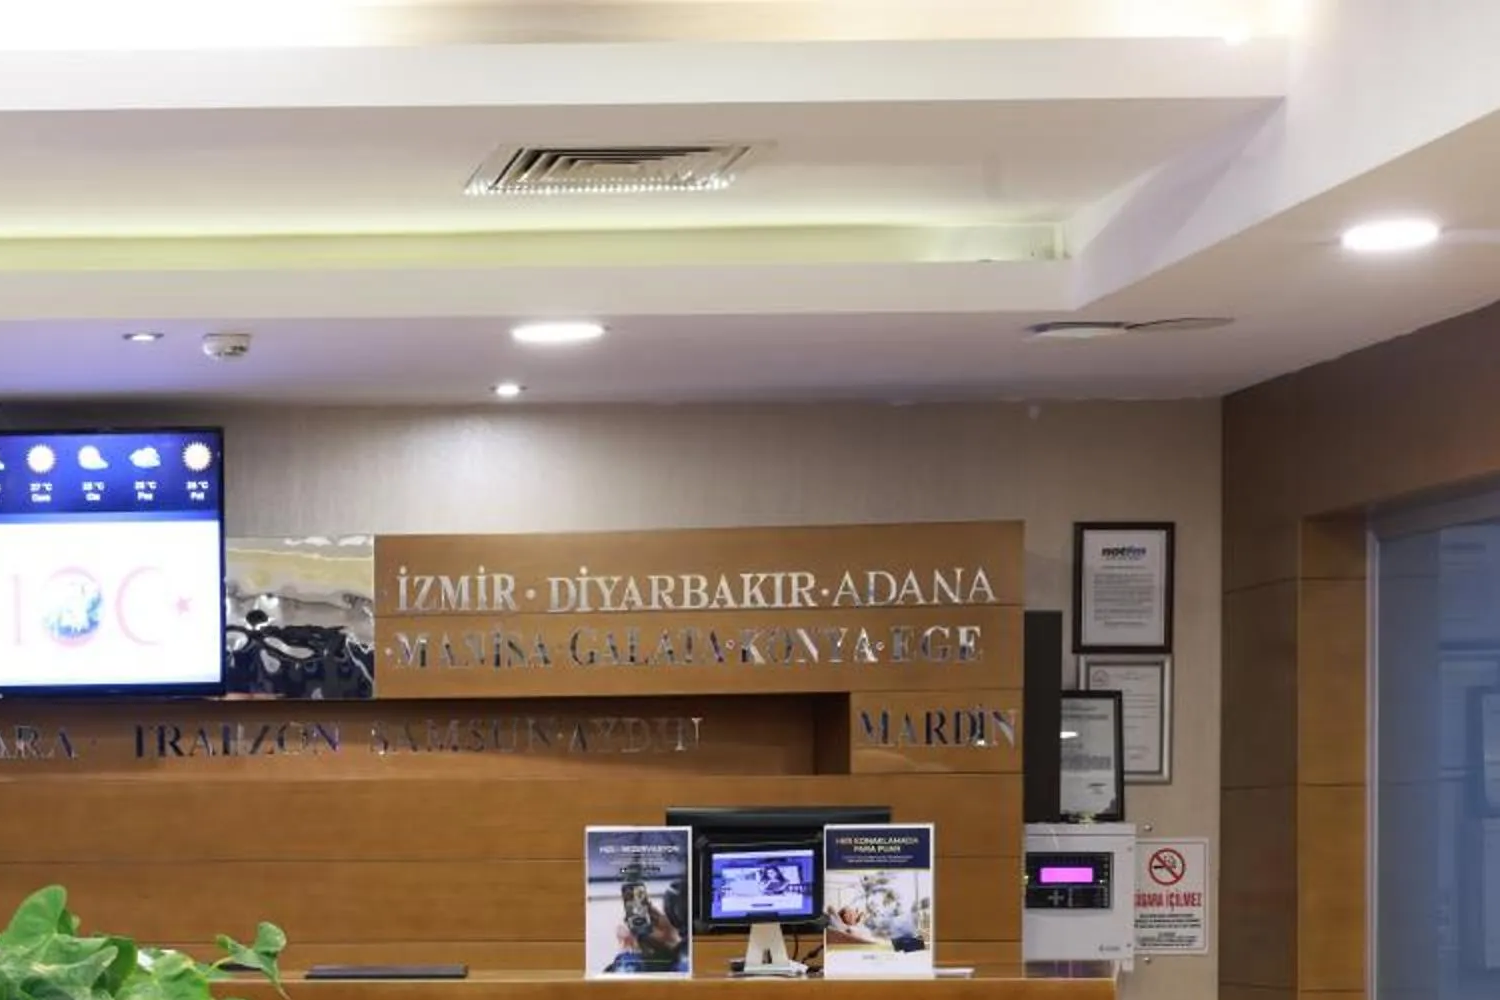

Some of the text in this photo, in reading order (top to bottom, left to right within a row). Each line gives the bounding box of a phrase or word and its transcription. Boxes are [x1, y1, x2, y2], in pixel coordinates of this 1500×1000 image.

[397, 565, 997, 613] İZMİR DİYARBAKIR ADANA
[569, 626, 725, 666] GALATA
[741, 626, 879, 665] KONYA
[891, 625, 982, 663] EGE
[857, 704, 1019, 747] MARDİN
